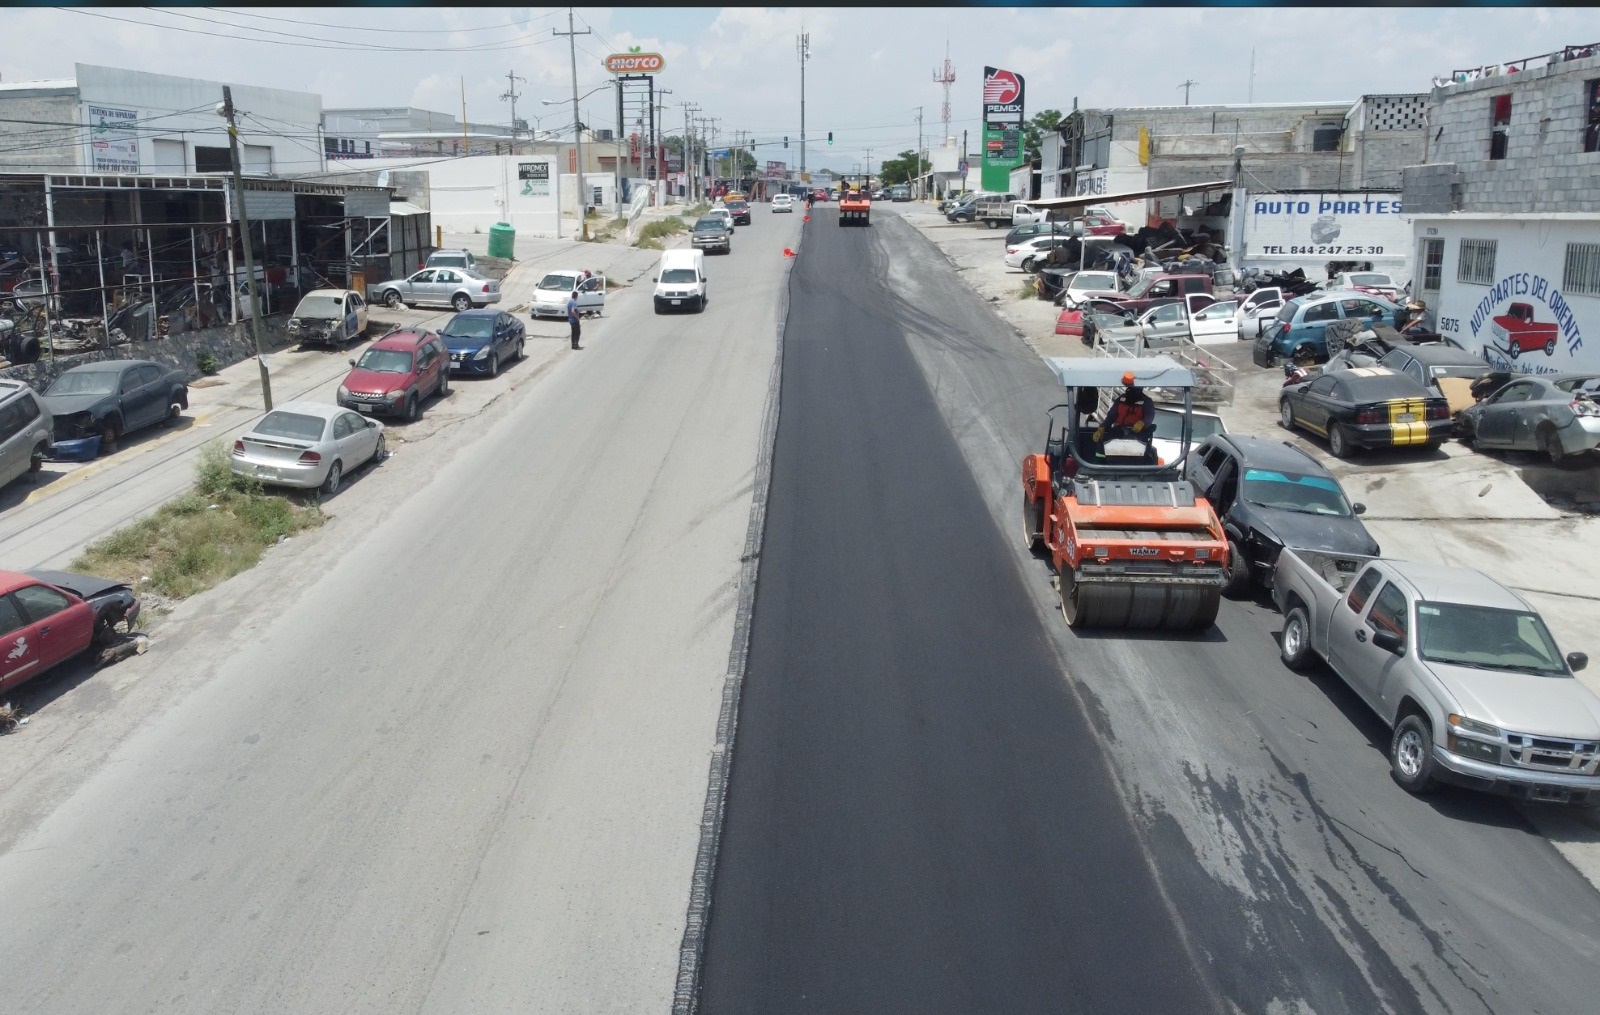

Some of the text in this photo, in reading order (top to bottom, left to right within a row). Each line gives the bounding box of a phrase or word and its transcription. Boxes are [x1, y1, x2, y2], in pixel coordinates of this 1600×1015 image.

[611, 57, 659, 68] merco
[1254, 200, 1402, 215] AUTO PARTES
[1531, 274, 1549, 303] DEL
[1549, 289, 1583, 357] ORIENTE
[1440, 317, 1460, 333] 5875
